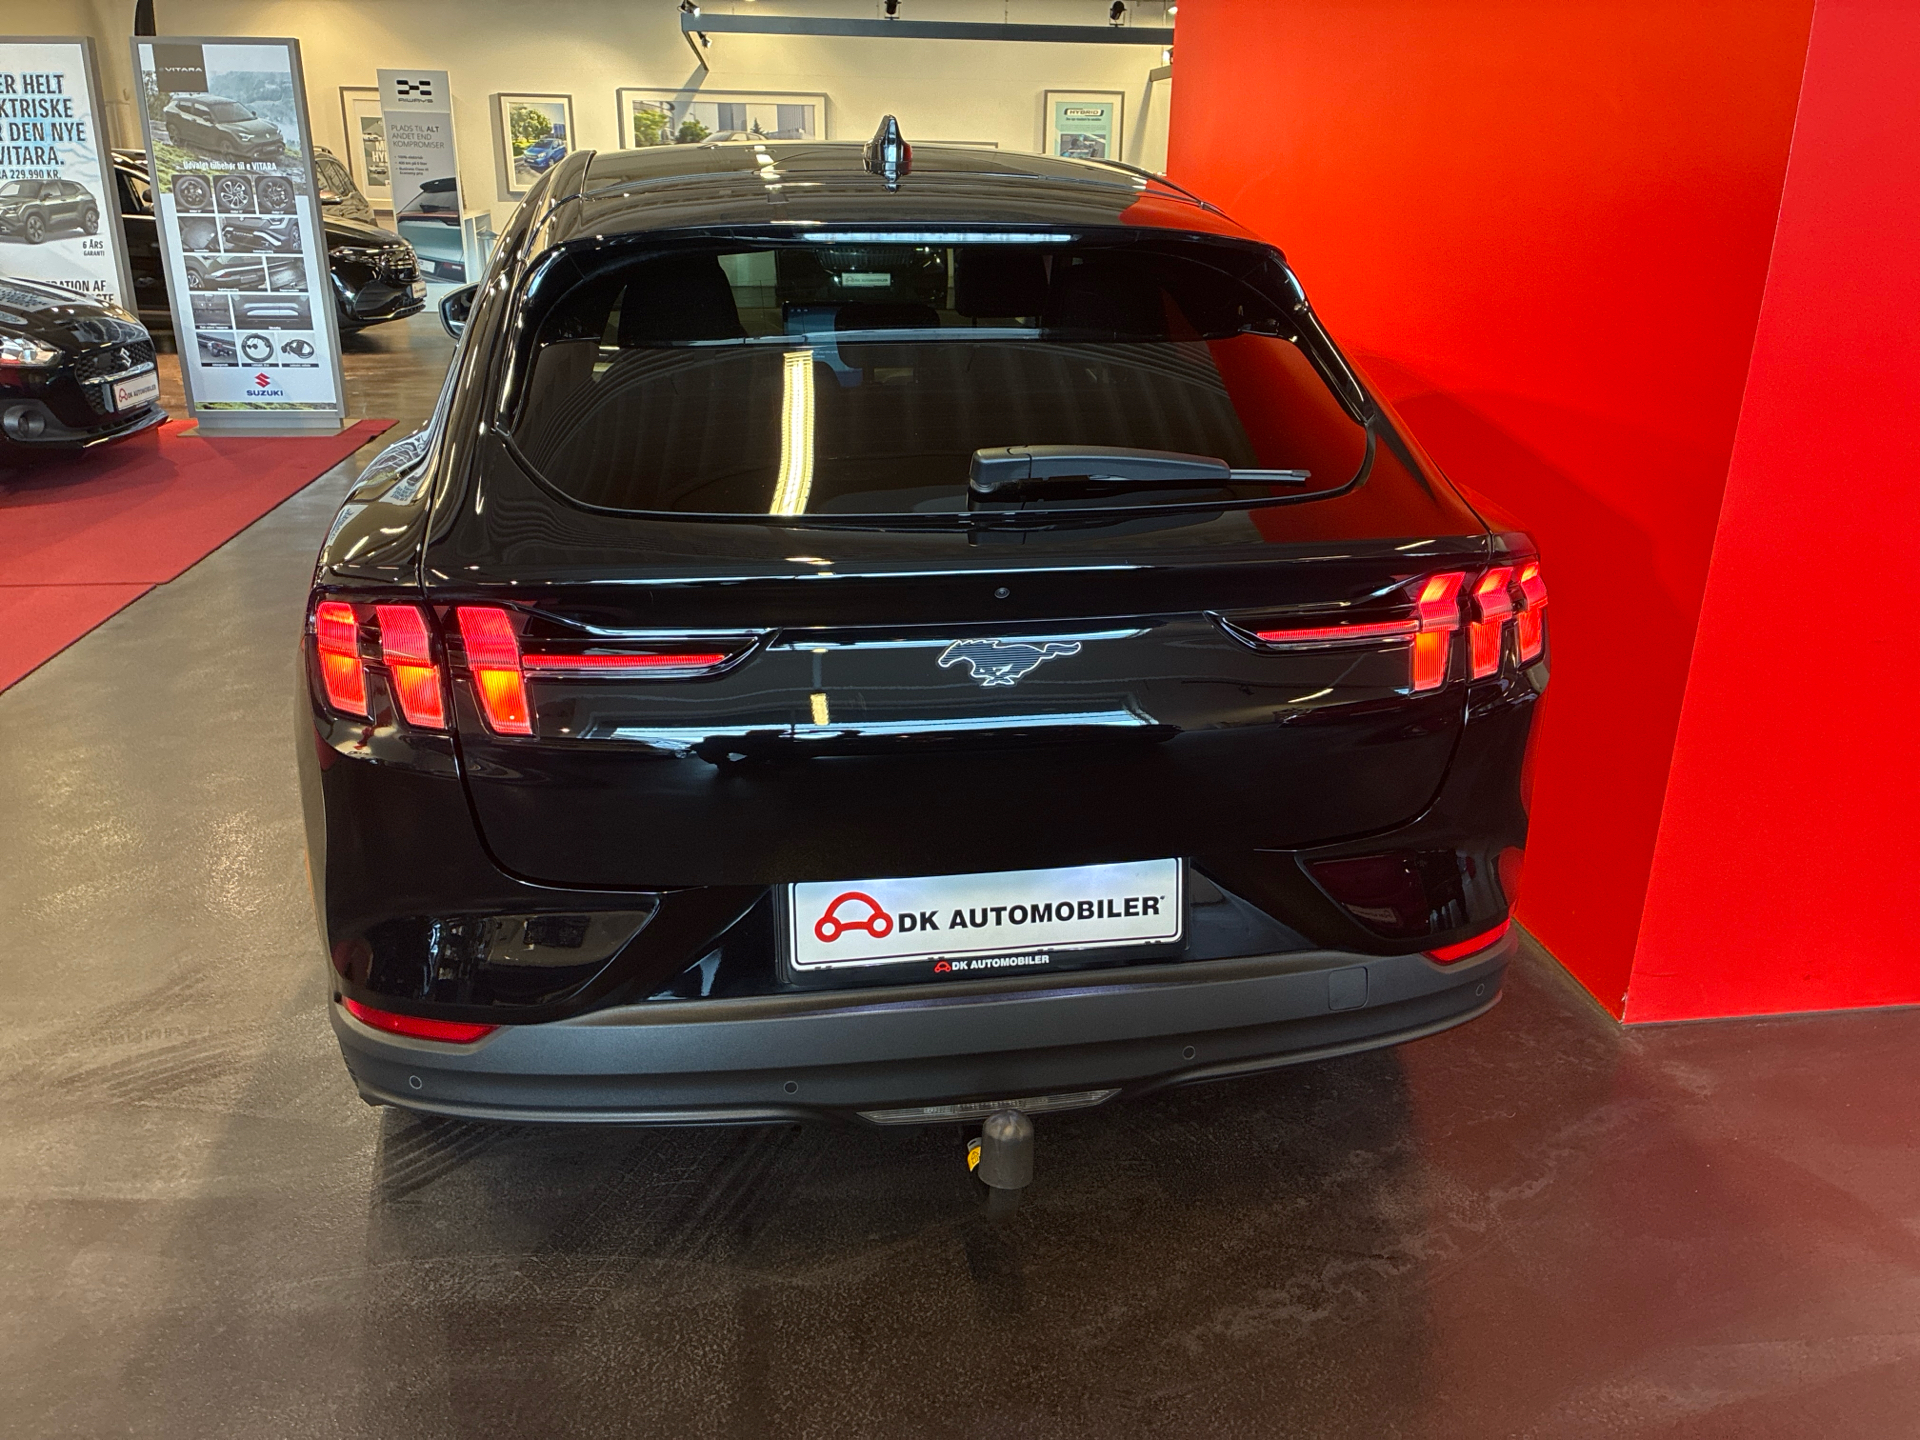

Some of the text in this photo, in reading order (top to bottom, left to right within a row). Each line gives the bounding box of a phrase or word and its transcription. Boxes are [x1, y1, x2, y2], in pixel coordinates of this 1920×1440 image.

[22, 74, 65, 94] HELT
[9, 122, 46, 142] DEN
[50, 122, 86, 142] NYE
[390, 124, 414, 133] PLADS
[414, 125, 425, 133] TIL
[391, 132, 432, 141] ANDET END
[392, 140, 445, 150] KOMPROMISER
[251, 162, 277, 170] VITARA
[10, 169, 44, 179] 229.990
[82, 239, 104, 250] 6 ÅRS
[92, 280, 107, 292] AF
[898, 895, 1161, 934] DK AUTOMOBILER
[951, 955, 1050, 971] DK AUTOMOBILER
